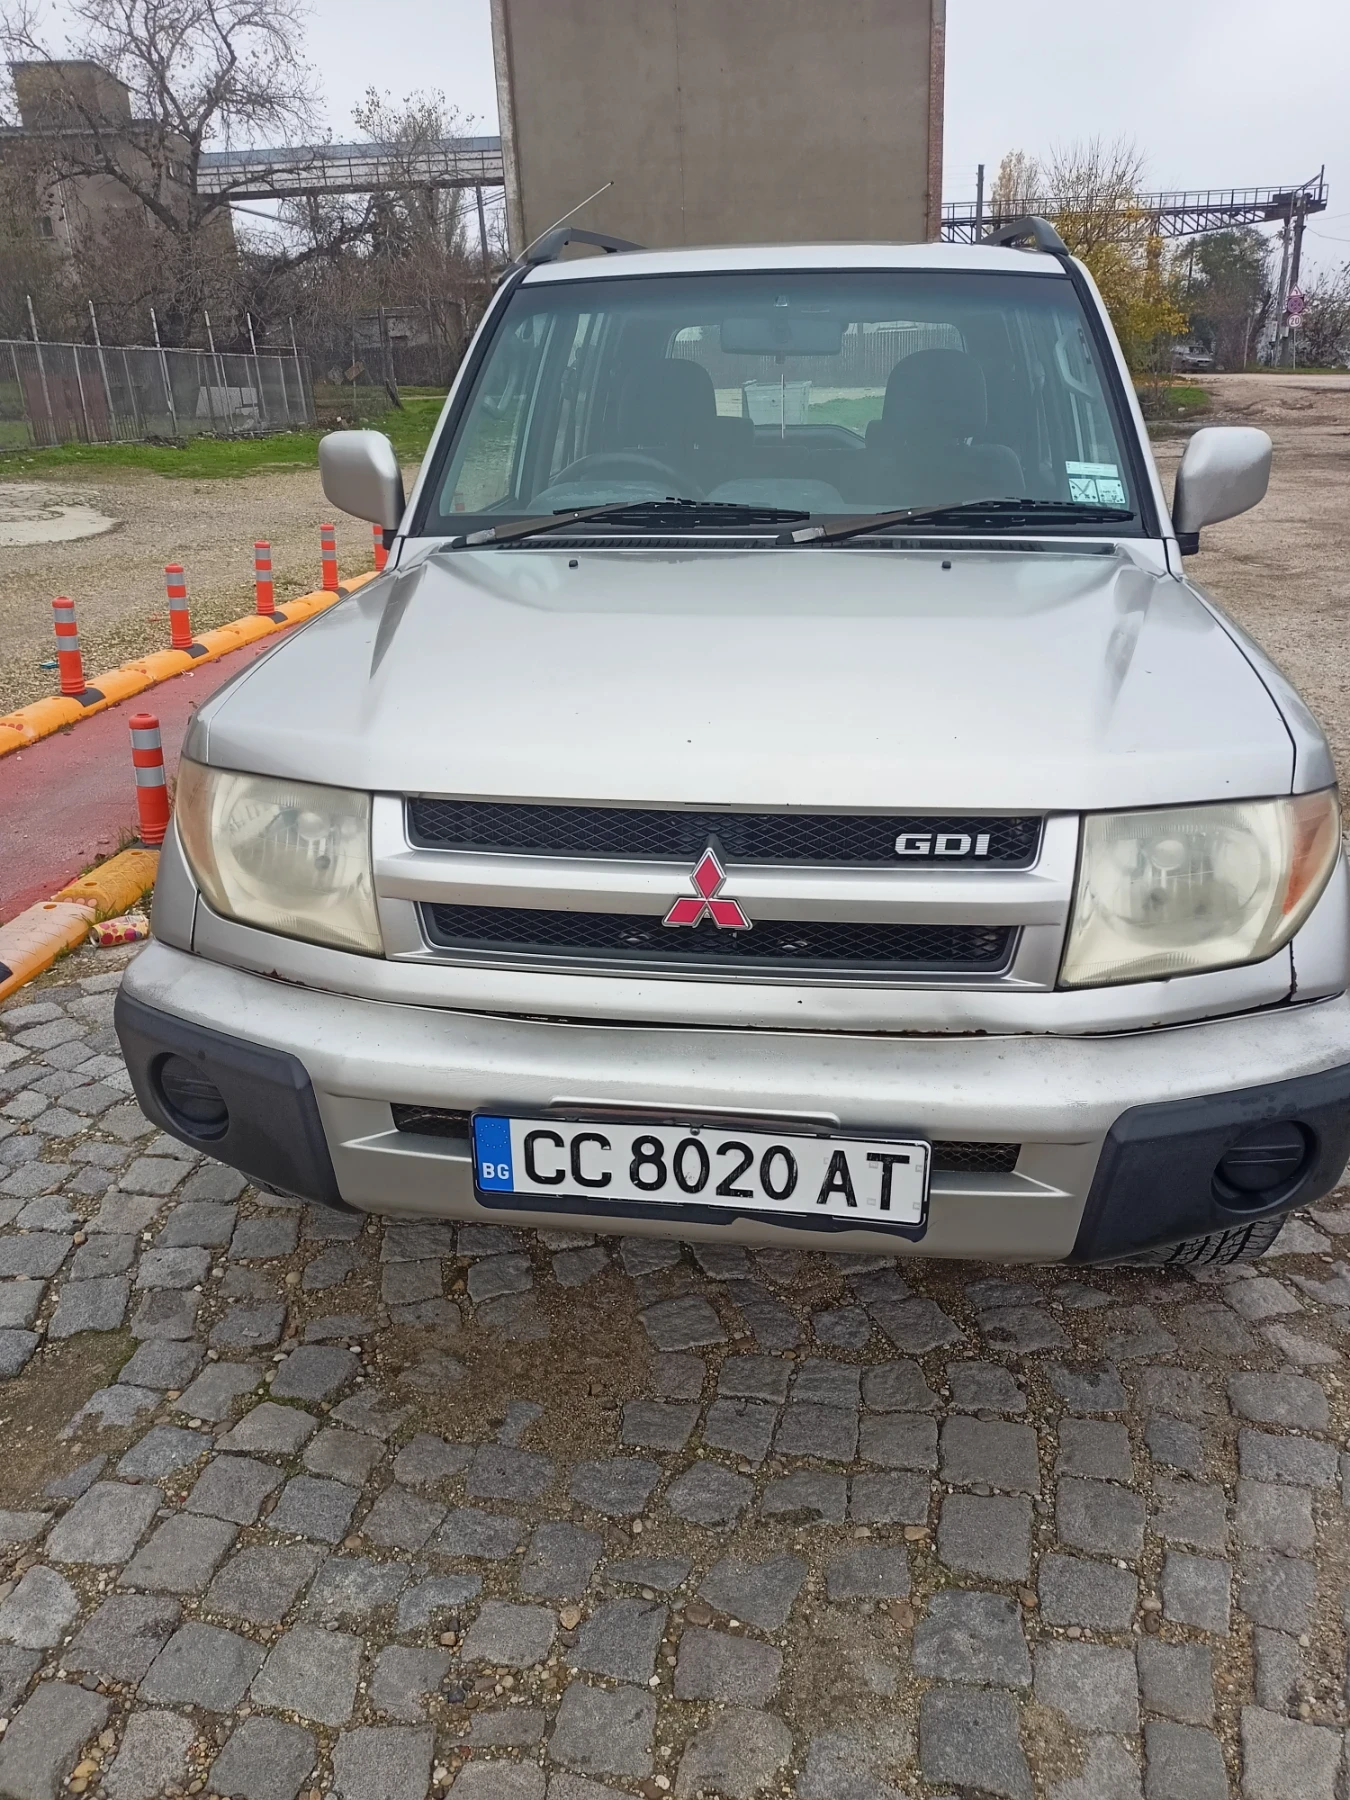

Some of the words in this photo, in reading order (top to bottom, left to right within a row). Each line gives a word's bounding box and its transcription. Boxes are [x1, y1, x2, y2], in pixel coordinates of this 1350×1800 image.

[1290, 317, 1300, 326] 20
[894, 833, 991, 856] GDI
[482, 1162, 510, 1180] BG
[523, 1129, 613, 1188] CC
[629, 1134, 799, 1201] 8020
[816, 1149, 911, 1211] AT
